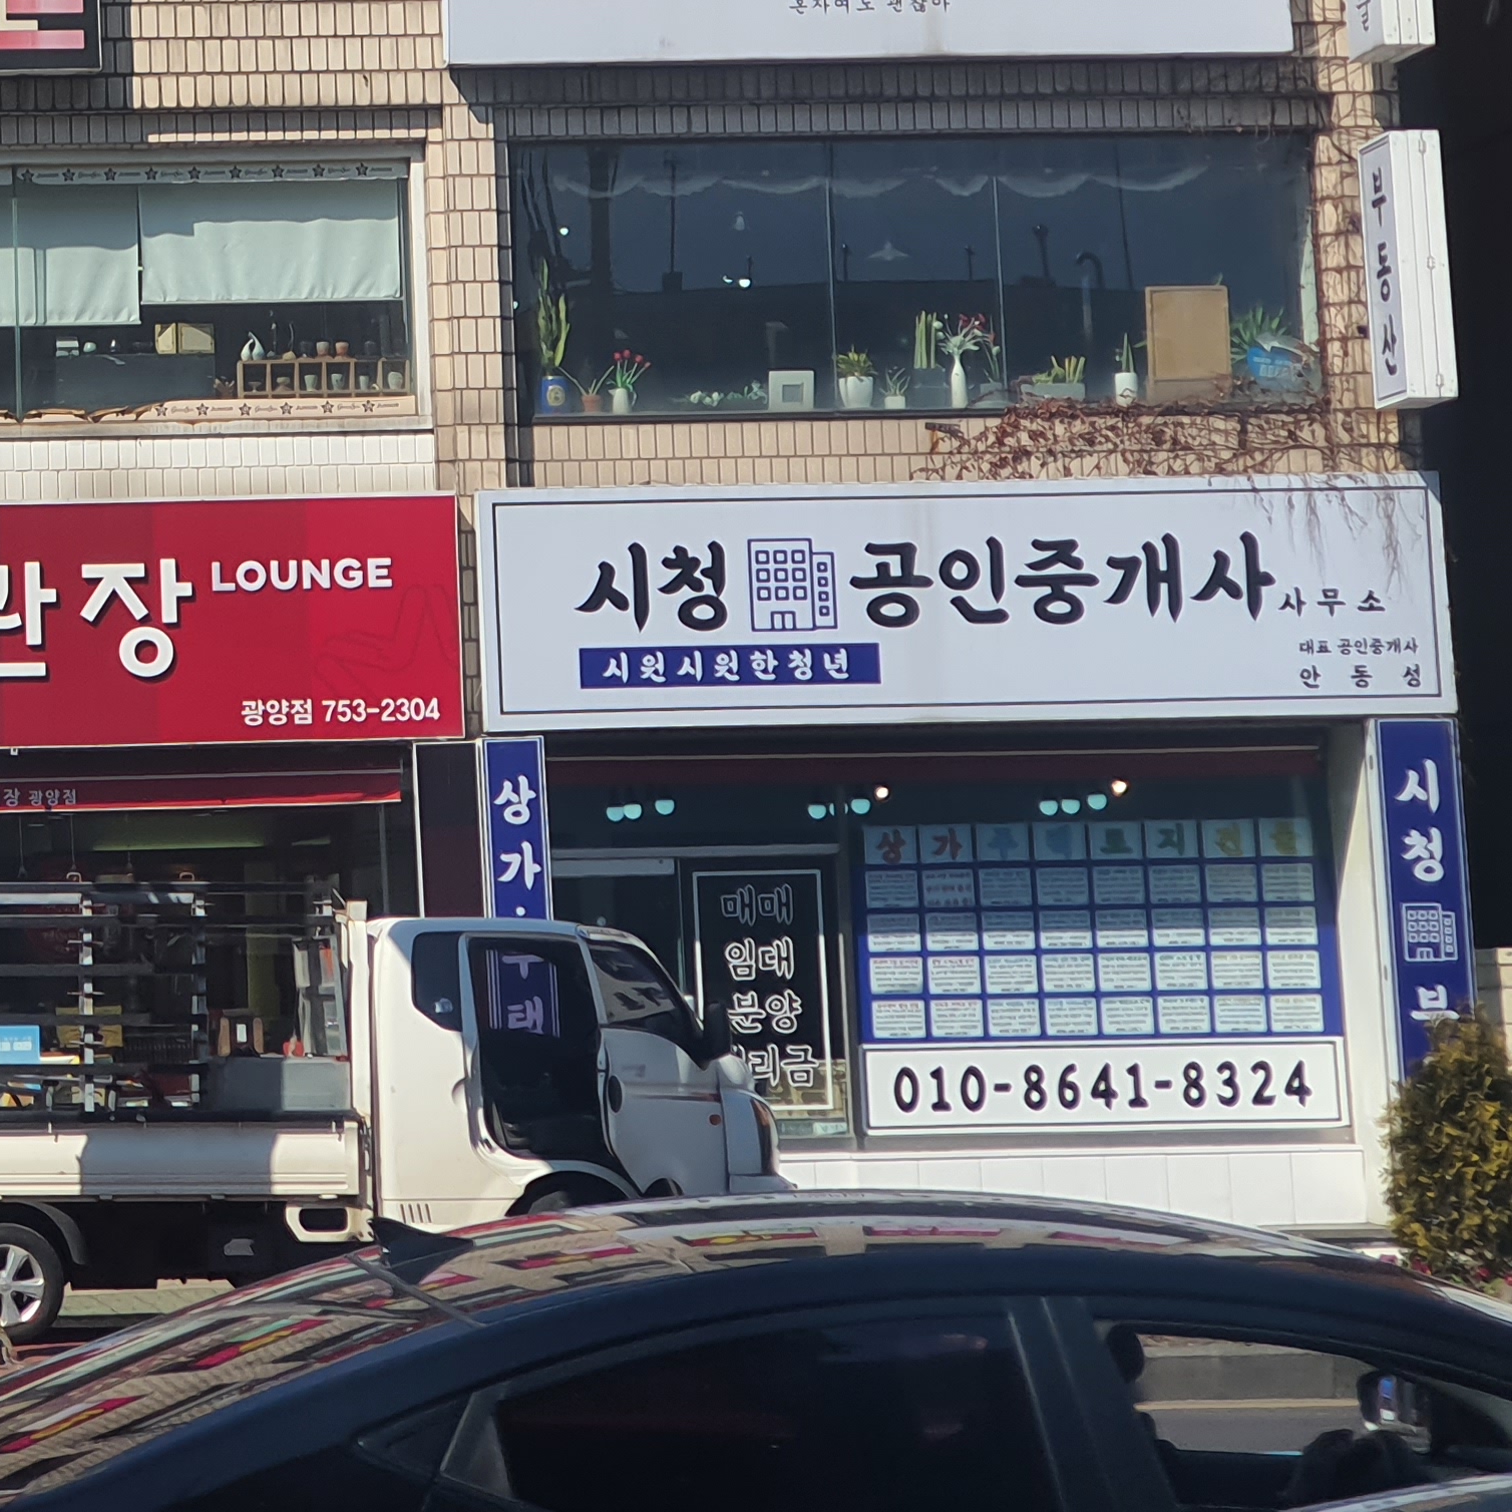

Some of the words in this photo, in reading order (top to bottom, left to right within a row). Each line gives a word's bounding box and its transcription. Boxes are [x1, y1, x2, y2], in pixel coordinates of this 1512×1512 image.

[1371, 166, 1398, 376] 부동산
[211, 556, 393, 593] LOUNGE
[573, 539, 729, 633] 시청
[848, 530, 1277, 628] 공인중개사
[1277, 586, 1387, 618] 사무소
[1298, 638, 1333, 656] 대표
[1336, 637, 1419, 656] 공인중개사
[240, 697, 314, 727] 광양점
[321, 695, 441, 724] 753-2304
[28, 788, 78, 807] 광양점
[1393, 757, 1445, 883] 시청
[720, 883, 795, 927] 매매
[724, 936, 795, 981] 임대
[727, 989, 803, 1035] 분양
[733, 1043, 821, 1088] 리금
[892, 1059, 1313, 1114] 010-8641-8324
